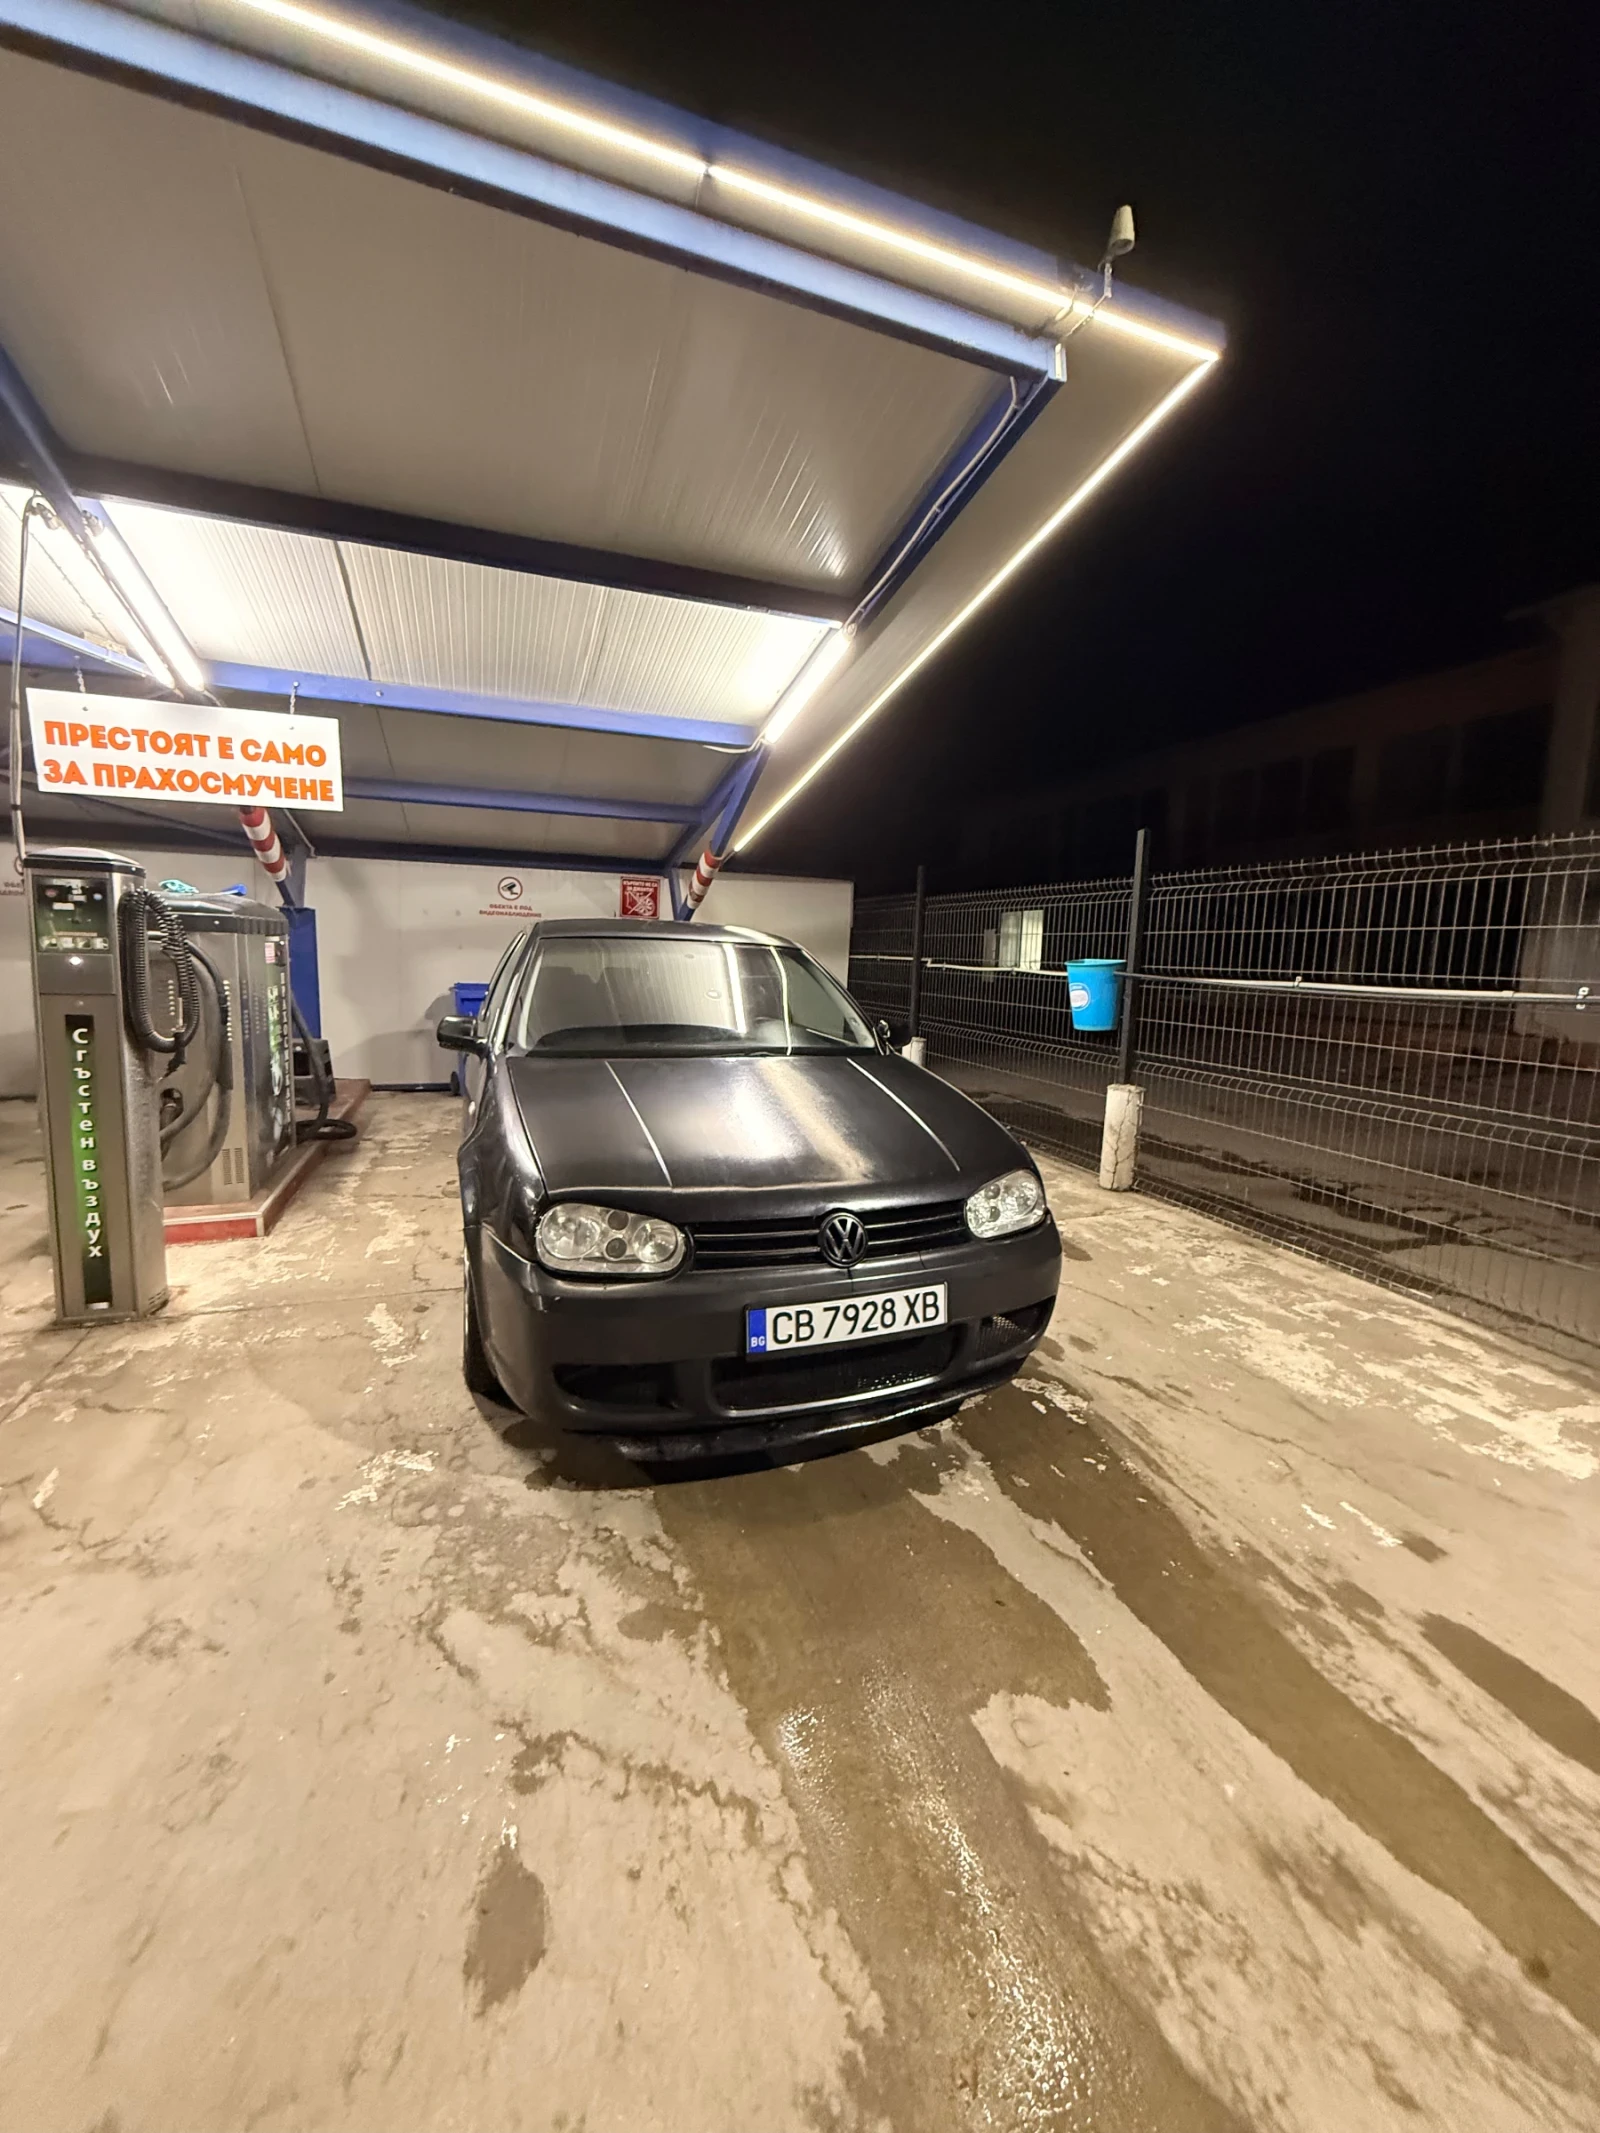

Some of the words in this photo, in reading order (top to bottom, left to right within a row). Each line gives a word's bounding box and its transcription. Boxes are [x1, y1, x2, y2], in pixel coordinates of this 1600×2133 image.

[44, 720, 211, 758] ПРЕСТОЯТ
[218, 736, 235, 760] Е
[240, 738, 327, 767] САМО
[44, 759, 88, 785] ЗА
[93, 762, 335, 802] ПРАХОСМУЧЕНЕ
[772, 1308, 815, 1345] CB
[822, 1297, 897, 1340] 7928
[903, 1290, 940, 1327] XB
[750, 1335, 766, 1348] BG
